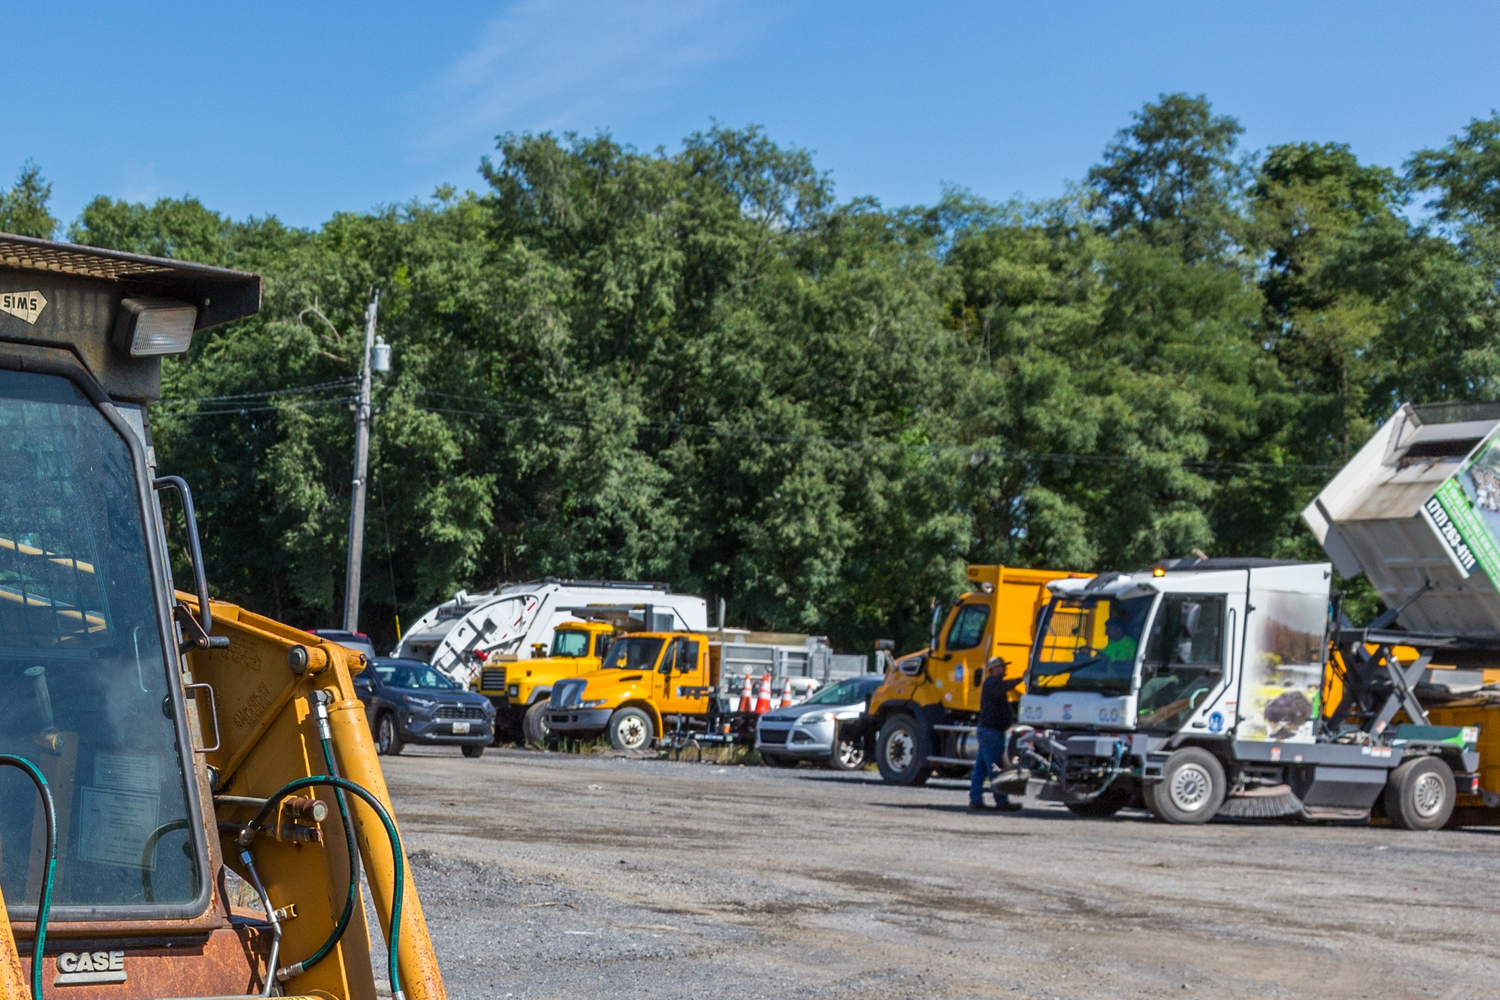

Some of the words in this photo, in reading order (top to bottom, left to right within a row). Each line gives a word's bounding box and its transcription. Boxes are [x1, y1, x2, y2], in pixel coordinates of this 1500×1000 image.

[3, 295, 37, 310] SIMS
[1442, 521, 1476, 570] 263-4111
[57, 951, 125, 973] CASE
